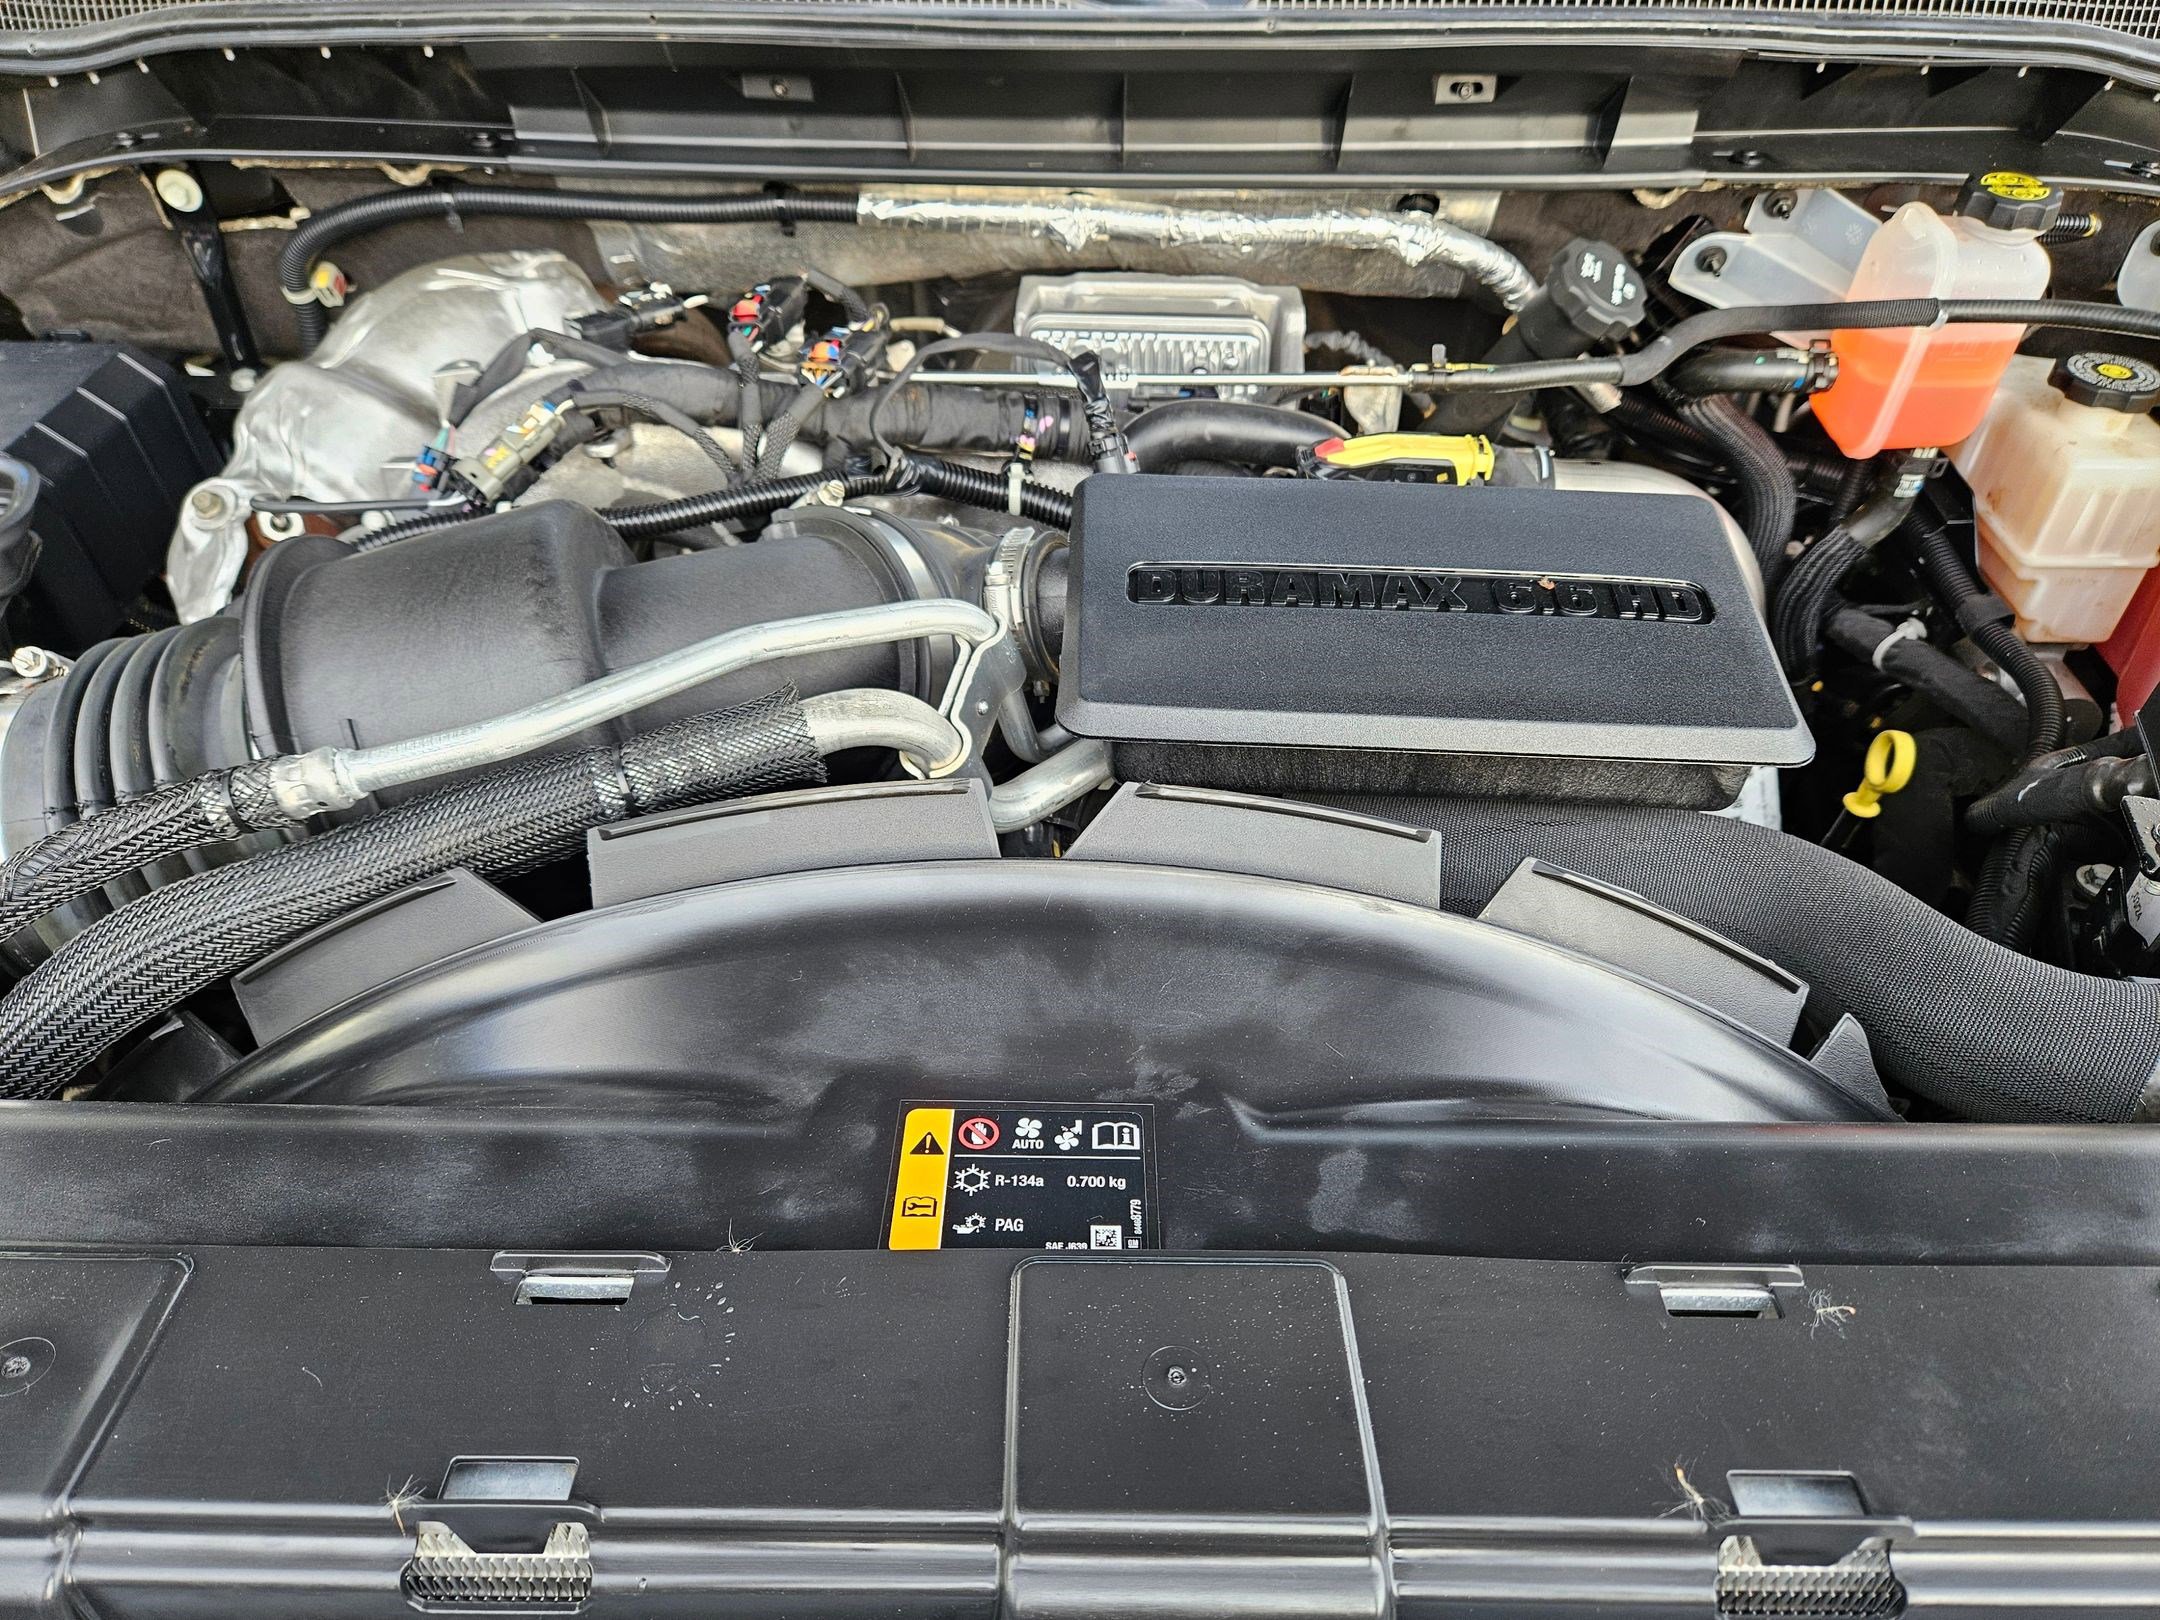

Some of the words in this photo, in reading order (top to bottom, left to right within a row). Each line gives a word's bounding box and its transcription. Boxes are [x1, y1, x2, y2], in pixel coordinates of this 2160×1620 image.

[1137, 570, 1467, 611] DURAMAX
[1492, 578, 1598, 616] 6.6
[1612, 584, 1702, 622] HD
[1012, 1139, 1044, 1150] AUTO
[994, 1175, 1044, 1187] R-134a
[1066, 1175, 1105, 1187] 0.700
[1108, 1176, 1126, 1190] kg
[994, 1218, 1024, 1232] PAG
